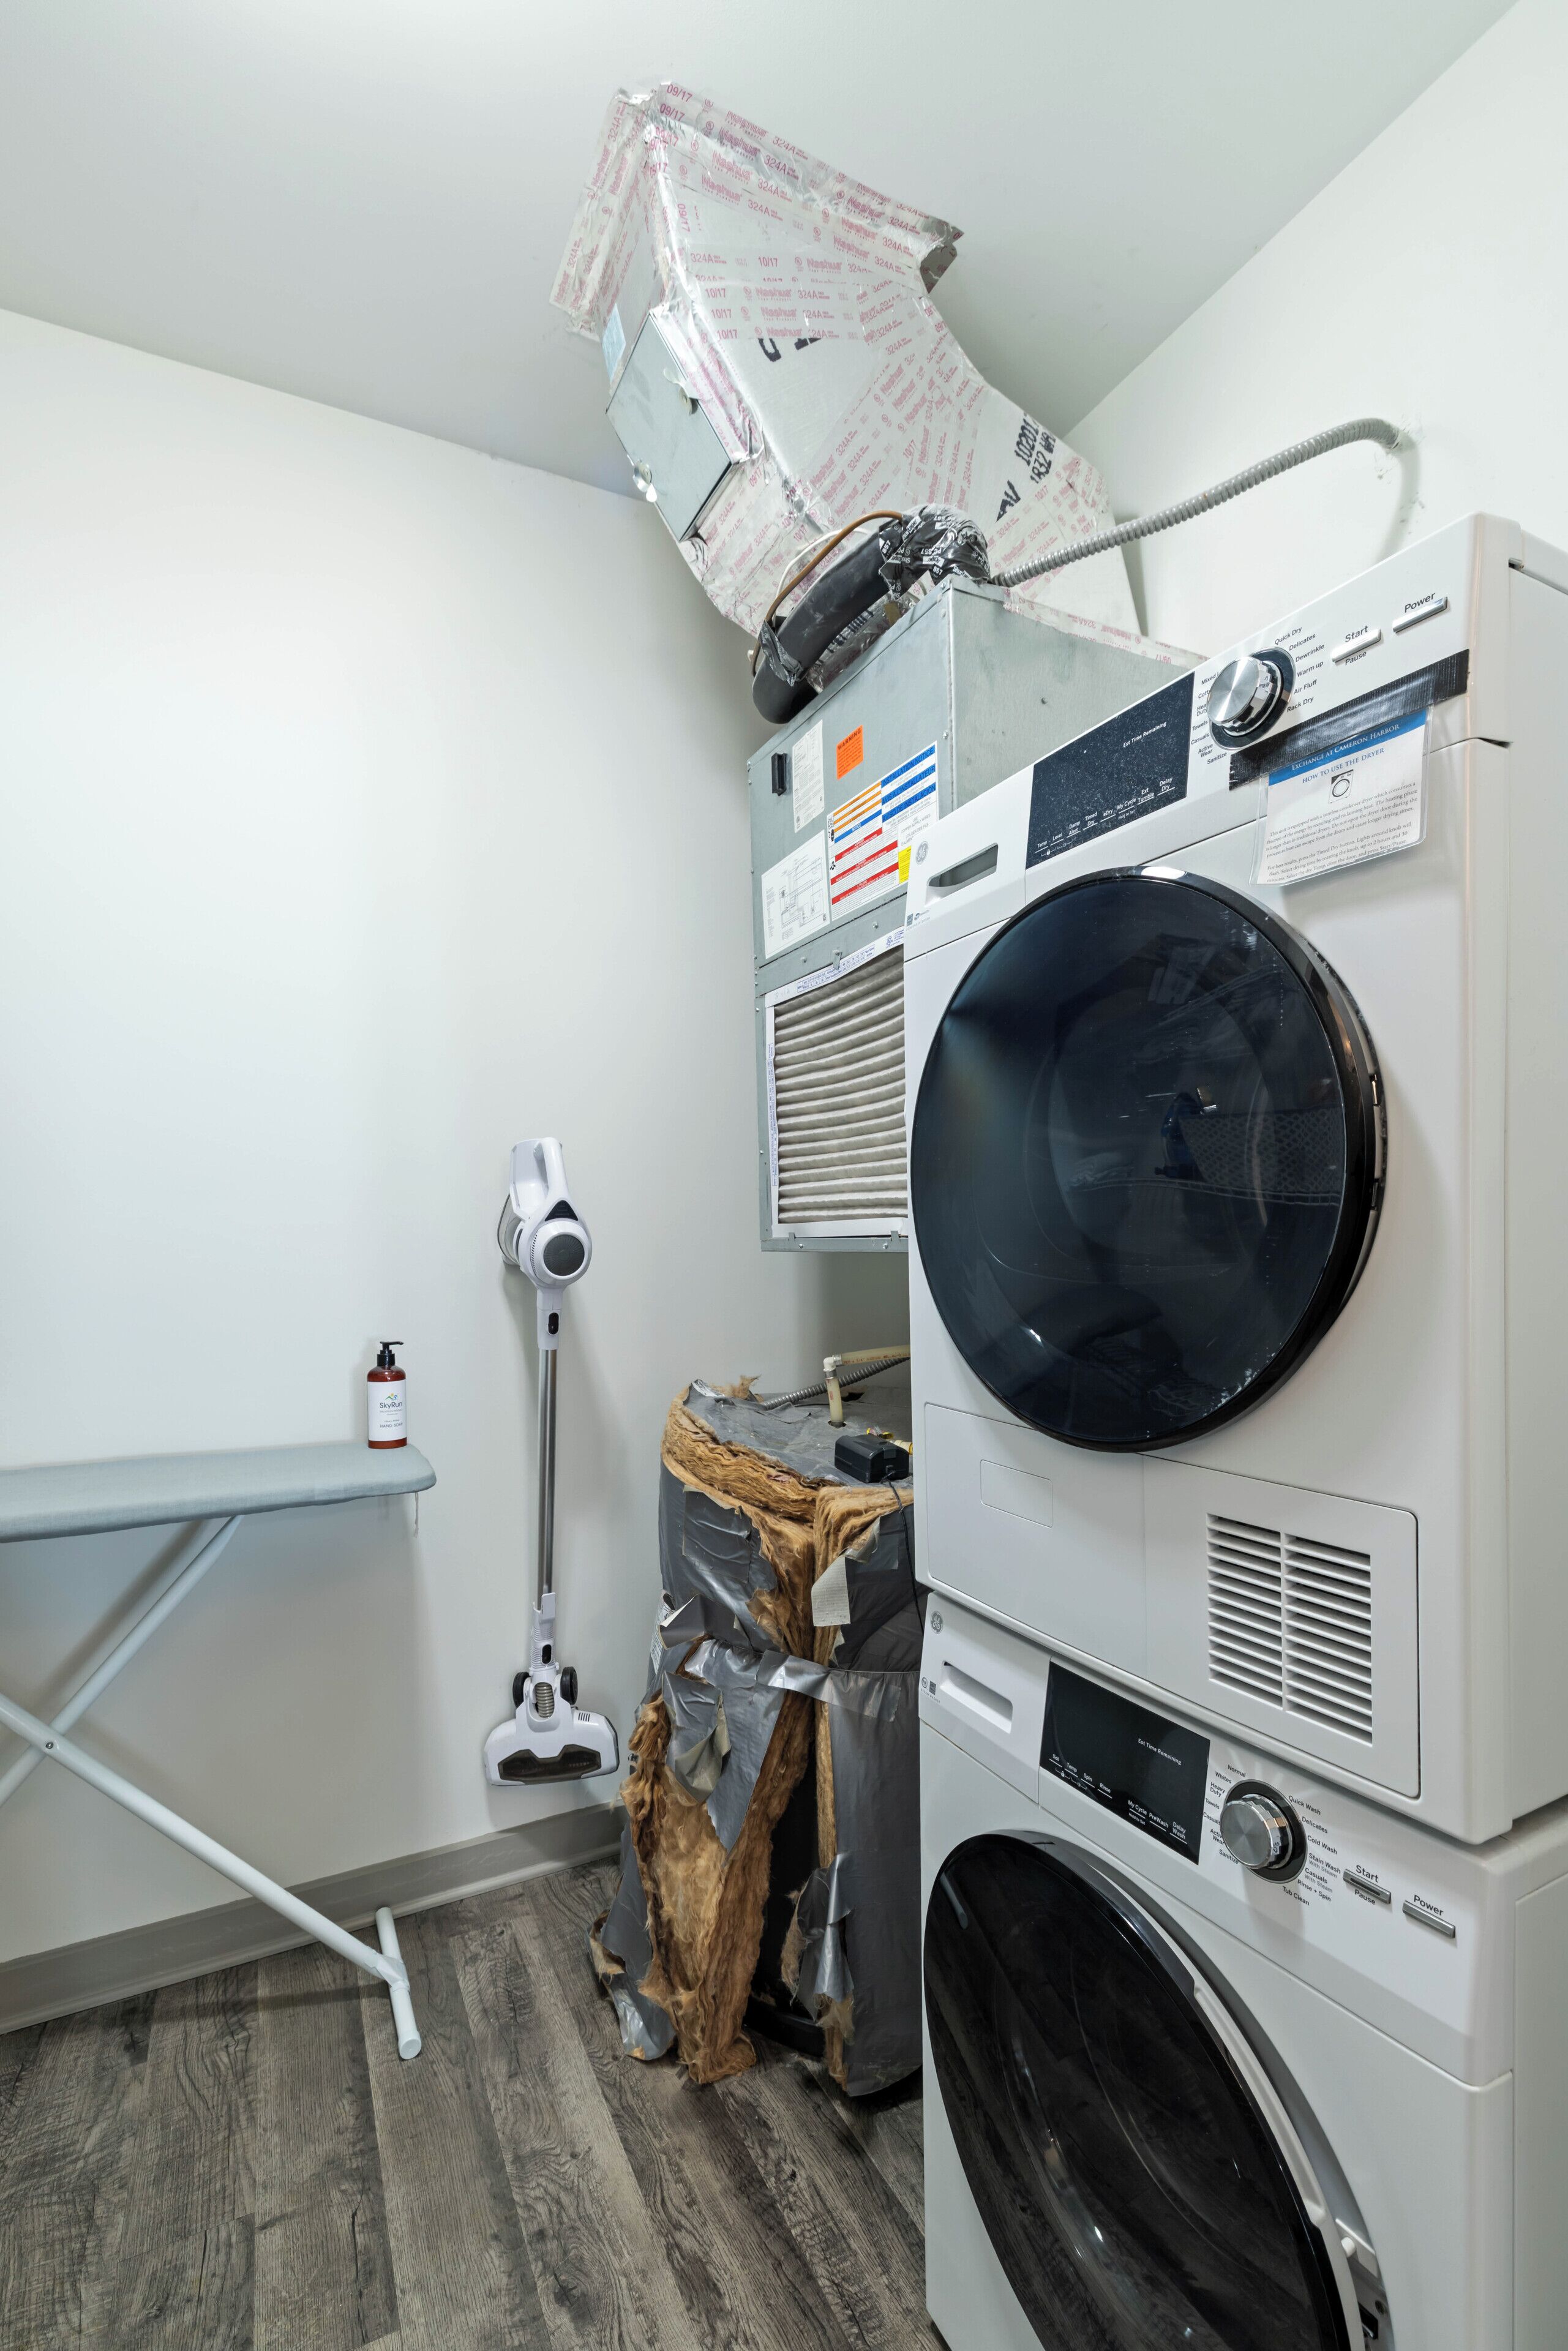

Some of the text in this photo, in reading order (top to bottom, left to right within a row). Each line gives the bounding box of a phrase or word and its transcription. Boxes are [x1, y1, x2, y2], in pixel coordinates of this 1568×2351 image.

[667, 84, 692, 102] 09/17
[660, 103, 685, 121] 09/17
[765, 155, 787, 174] 324A
[713, 151, 780, 198] Nashua 324A
[691, 253, 778, 268] 324A 10/17
[882, 540, 891, 554] 857
[932, 566, 943, 576] 857
[1405, 593, 1435, 613] Power
[1275, 627, 1302, 645] Quick Dry
[1345, 625, 1368, 642] Start
[1289, 633, 1316, 651] Delicates
[1296, 644, 1324, 662] Dewrinkle
[1345, 651, 1367, 666] Pause
[1297, 661, 1324, 677] Warm up
[1201, 673, 1216, 685] Mixed
[1304, 679, 1317, 691] Fluff
[1198, 690, 1210, 699] Cott
[1287, 697, 1313, 713] Rack Dry
[1131, 735, 1142, 744] Time
[1143, 722, 1167, 738] Remaining
[1193, 721, 1208, 731] Towels
[838, 728, 861, 751] WARNING
[1191, 733, 1209, 744] Casuals
[1198, 743, 1213, 754] Active
[1201, 749, 1212, 758] Wear
[1292, 755, 1324, 771] EXCHANGE
[1334, 737, 1368, 753] CAMERON
[1370, 724, 1400, 739] HARBOR
[1207, 752, 1227, 765] Sanitize
[1302, 748, 1384, 784] HOW TO USE THE DRYER
[882, 748, 933, 787] INSTALLATION NOTICE
[1159, 777, 1172, 786] Delay
[1124, 798, 1136, 808] Cycle
[1138, 792, 1155, 803] Tumble
[1069, 820, 1080, 830] Damp
[1085, 812, 1097, 822] Timed
[1270, 842, 1281, 851] longer
[1296, 829, 1316, 841] traditional
[1317, 824, 1330, 834] dryers.
[1367, 808, 1379, 817] dryer
[1380, 804, 1392, 812] door
[1392, 798, 1408, 810] during
[1068, 827, 1078, 836] Alert
[1316, 847, 1329, 855] Timed
[1339, 838, 1355, 848] button.
[1356, 833, 1370, 843] Lights
[1371, 828, 1388, 839] around
[1389, 823, 1401, 833] knob
[1037, 840, 1048, 849] Temp
[1146, 1742, 1157, 1752] Time
[1158, 1749, 1182, 1766] Remaining
[1067, 1762, 1078, 1772] Temp
[1228, 1764, 1246, 1778] Normal
[1083, 1773, 1092, 1782] Spin
[1215, 1771, 1232, 1784] Whites
[1100, 1783, 1111, 1793] Rinse
[1210, 1782, 1225, 1794] Heavy
[1210, 1787, 1221, 1798] Duty
[1128, 1799, 1147, 1815] My Cycle
[1205, 1798, 1220, 1809] Towels
[1289, 1795, 1321, 1815] Quick Wash
[1149, 1812, 1169, 1828] PreWash
[1172, 1821, 1186, 1833] Delay
[1302, 1817, 1328, 1834] Delicates
[1172, 1828, 1186, 1839] Wash
[1210, 1828, 1222, 1838] Activ
[1213, 1835, 1225, 1845] Wear
[1307, 1835, 1337, 1855] Cold Wash
[1219, 1849, 1239, 1864] Sanitize
[1309, 1853, 1341, 1874] Stain Wash
[1305, 1867, 1327, 1883] Casuals
[1309, 1860, 1337, 1878] With Steam
[1356, 1865, 1379, 1883] Start
[1297, 1880, 1312, 1891] Rinse
[1318, 1891, 1331, 1902] Spin
[1305, 1874, 1333, 1893] With Steam
[1283, 1886, 1310, 1906] Tub Clean
[1355, 1889, 1376, 1905] Pause
[1414, 1894, 1444, 1916] Power
